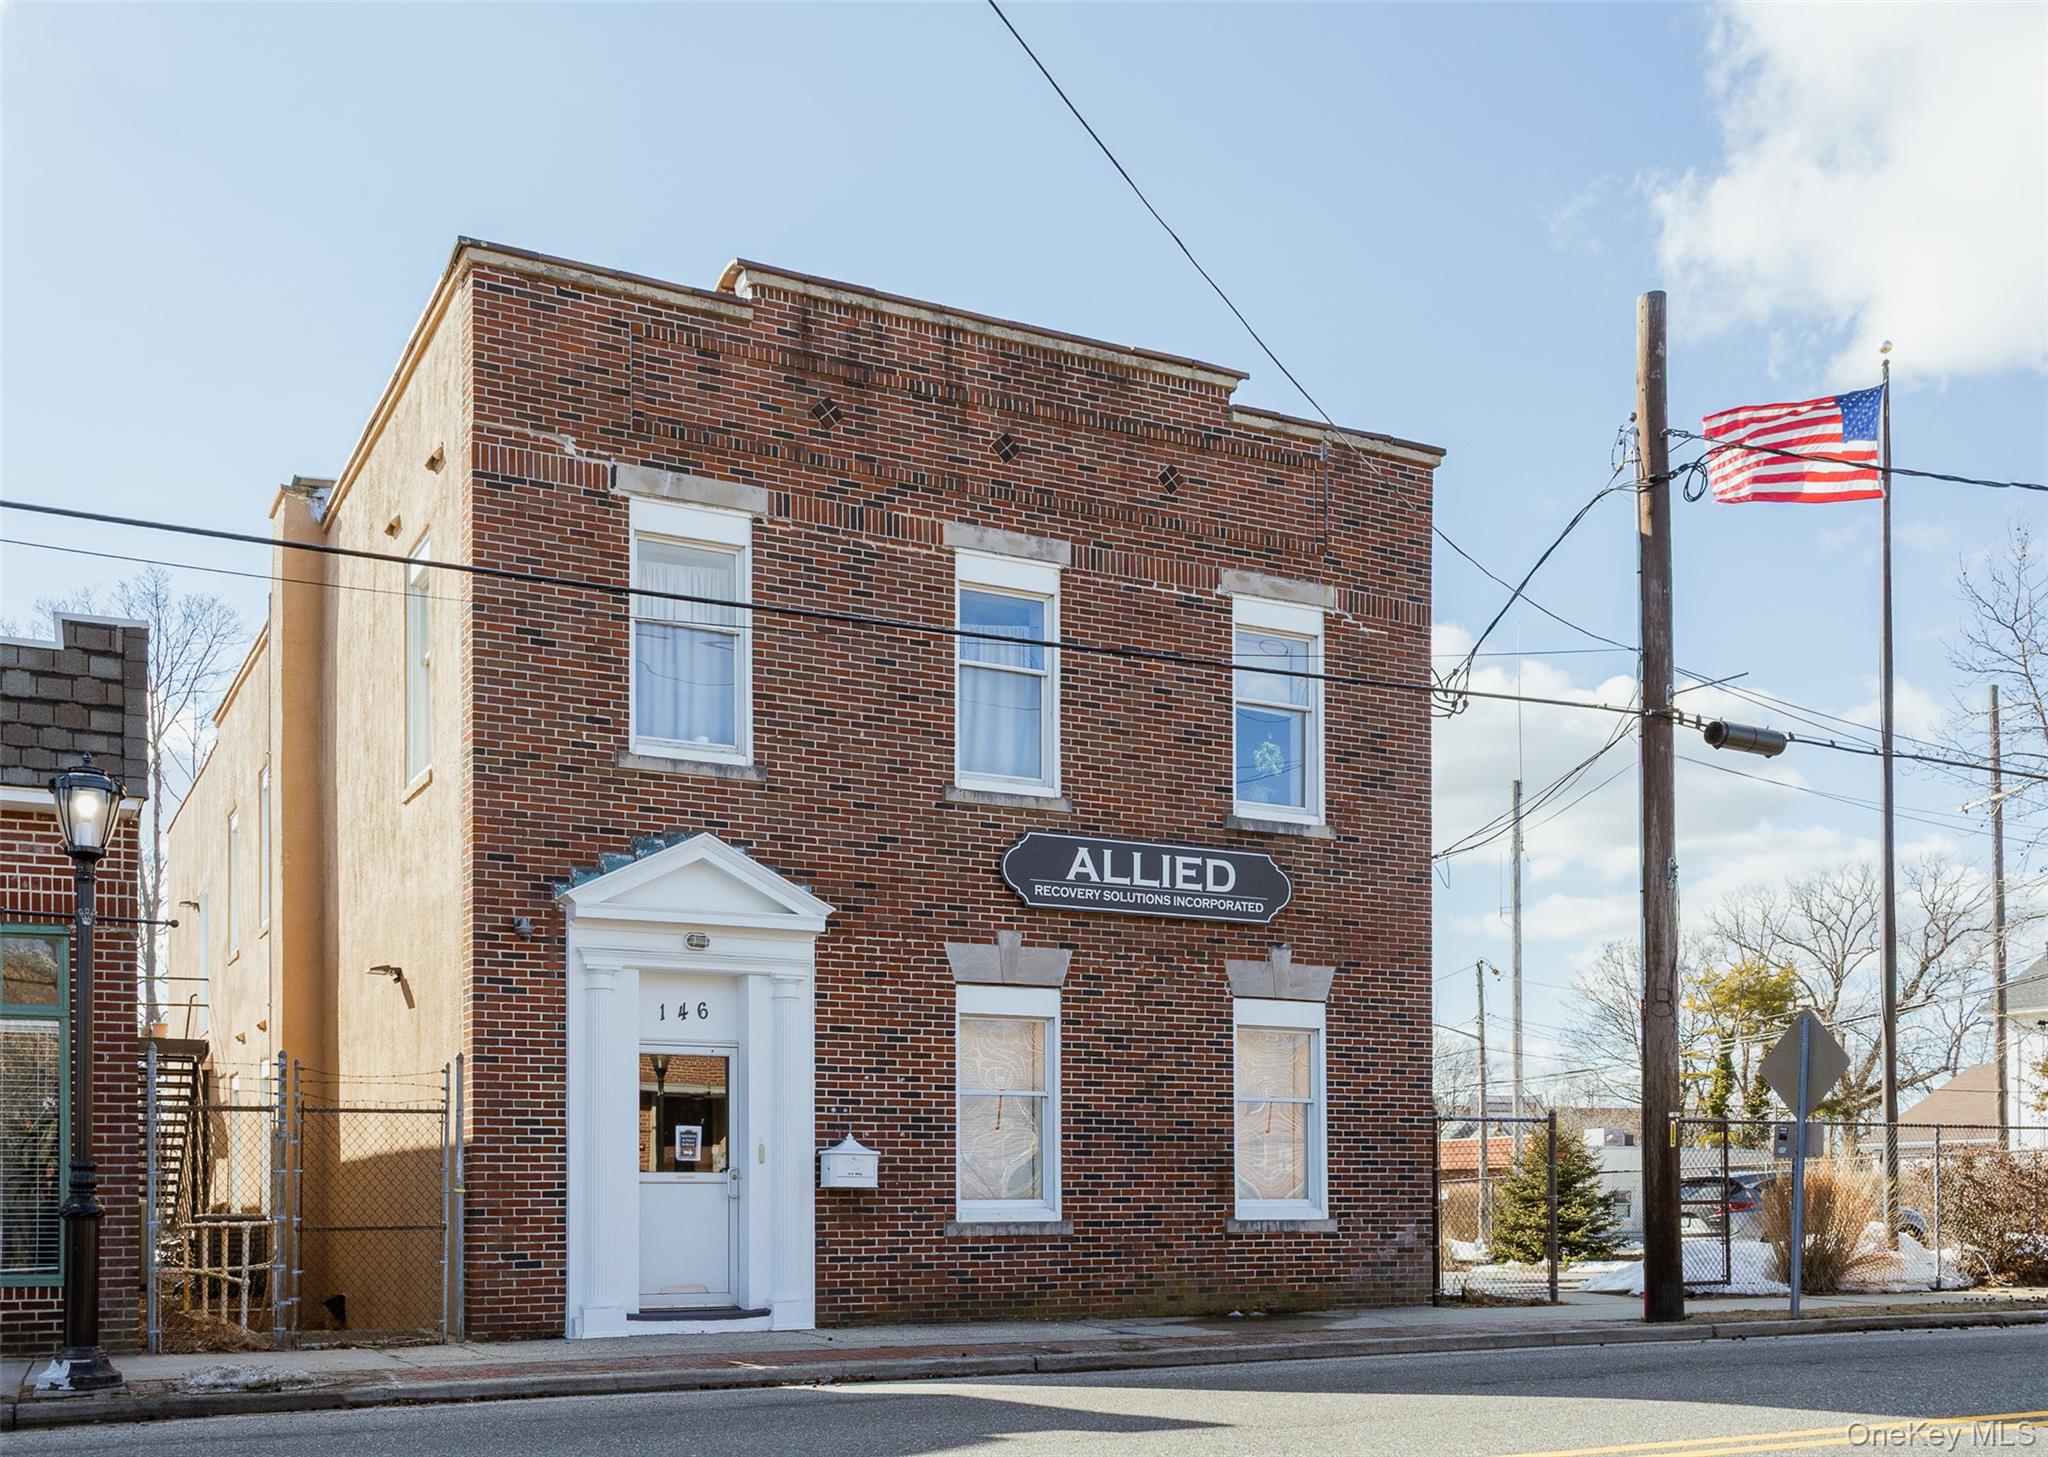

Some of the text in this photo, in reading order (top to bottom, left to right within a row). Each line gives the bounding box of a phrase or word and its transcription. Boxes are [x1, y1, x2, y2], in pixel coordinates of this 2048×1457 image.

[1065, 846, 1236, 893] ALLIED
[1034, 884, 1264, 913] RECOVERY SOLUTIONS INCORPORATED
[660, 1001, 709, 1021] 146
